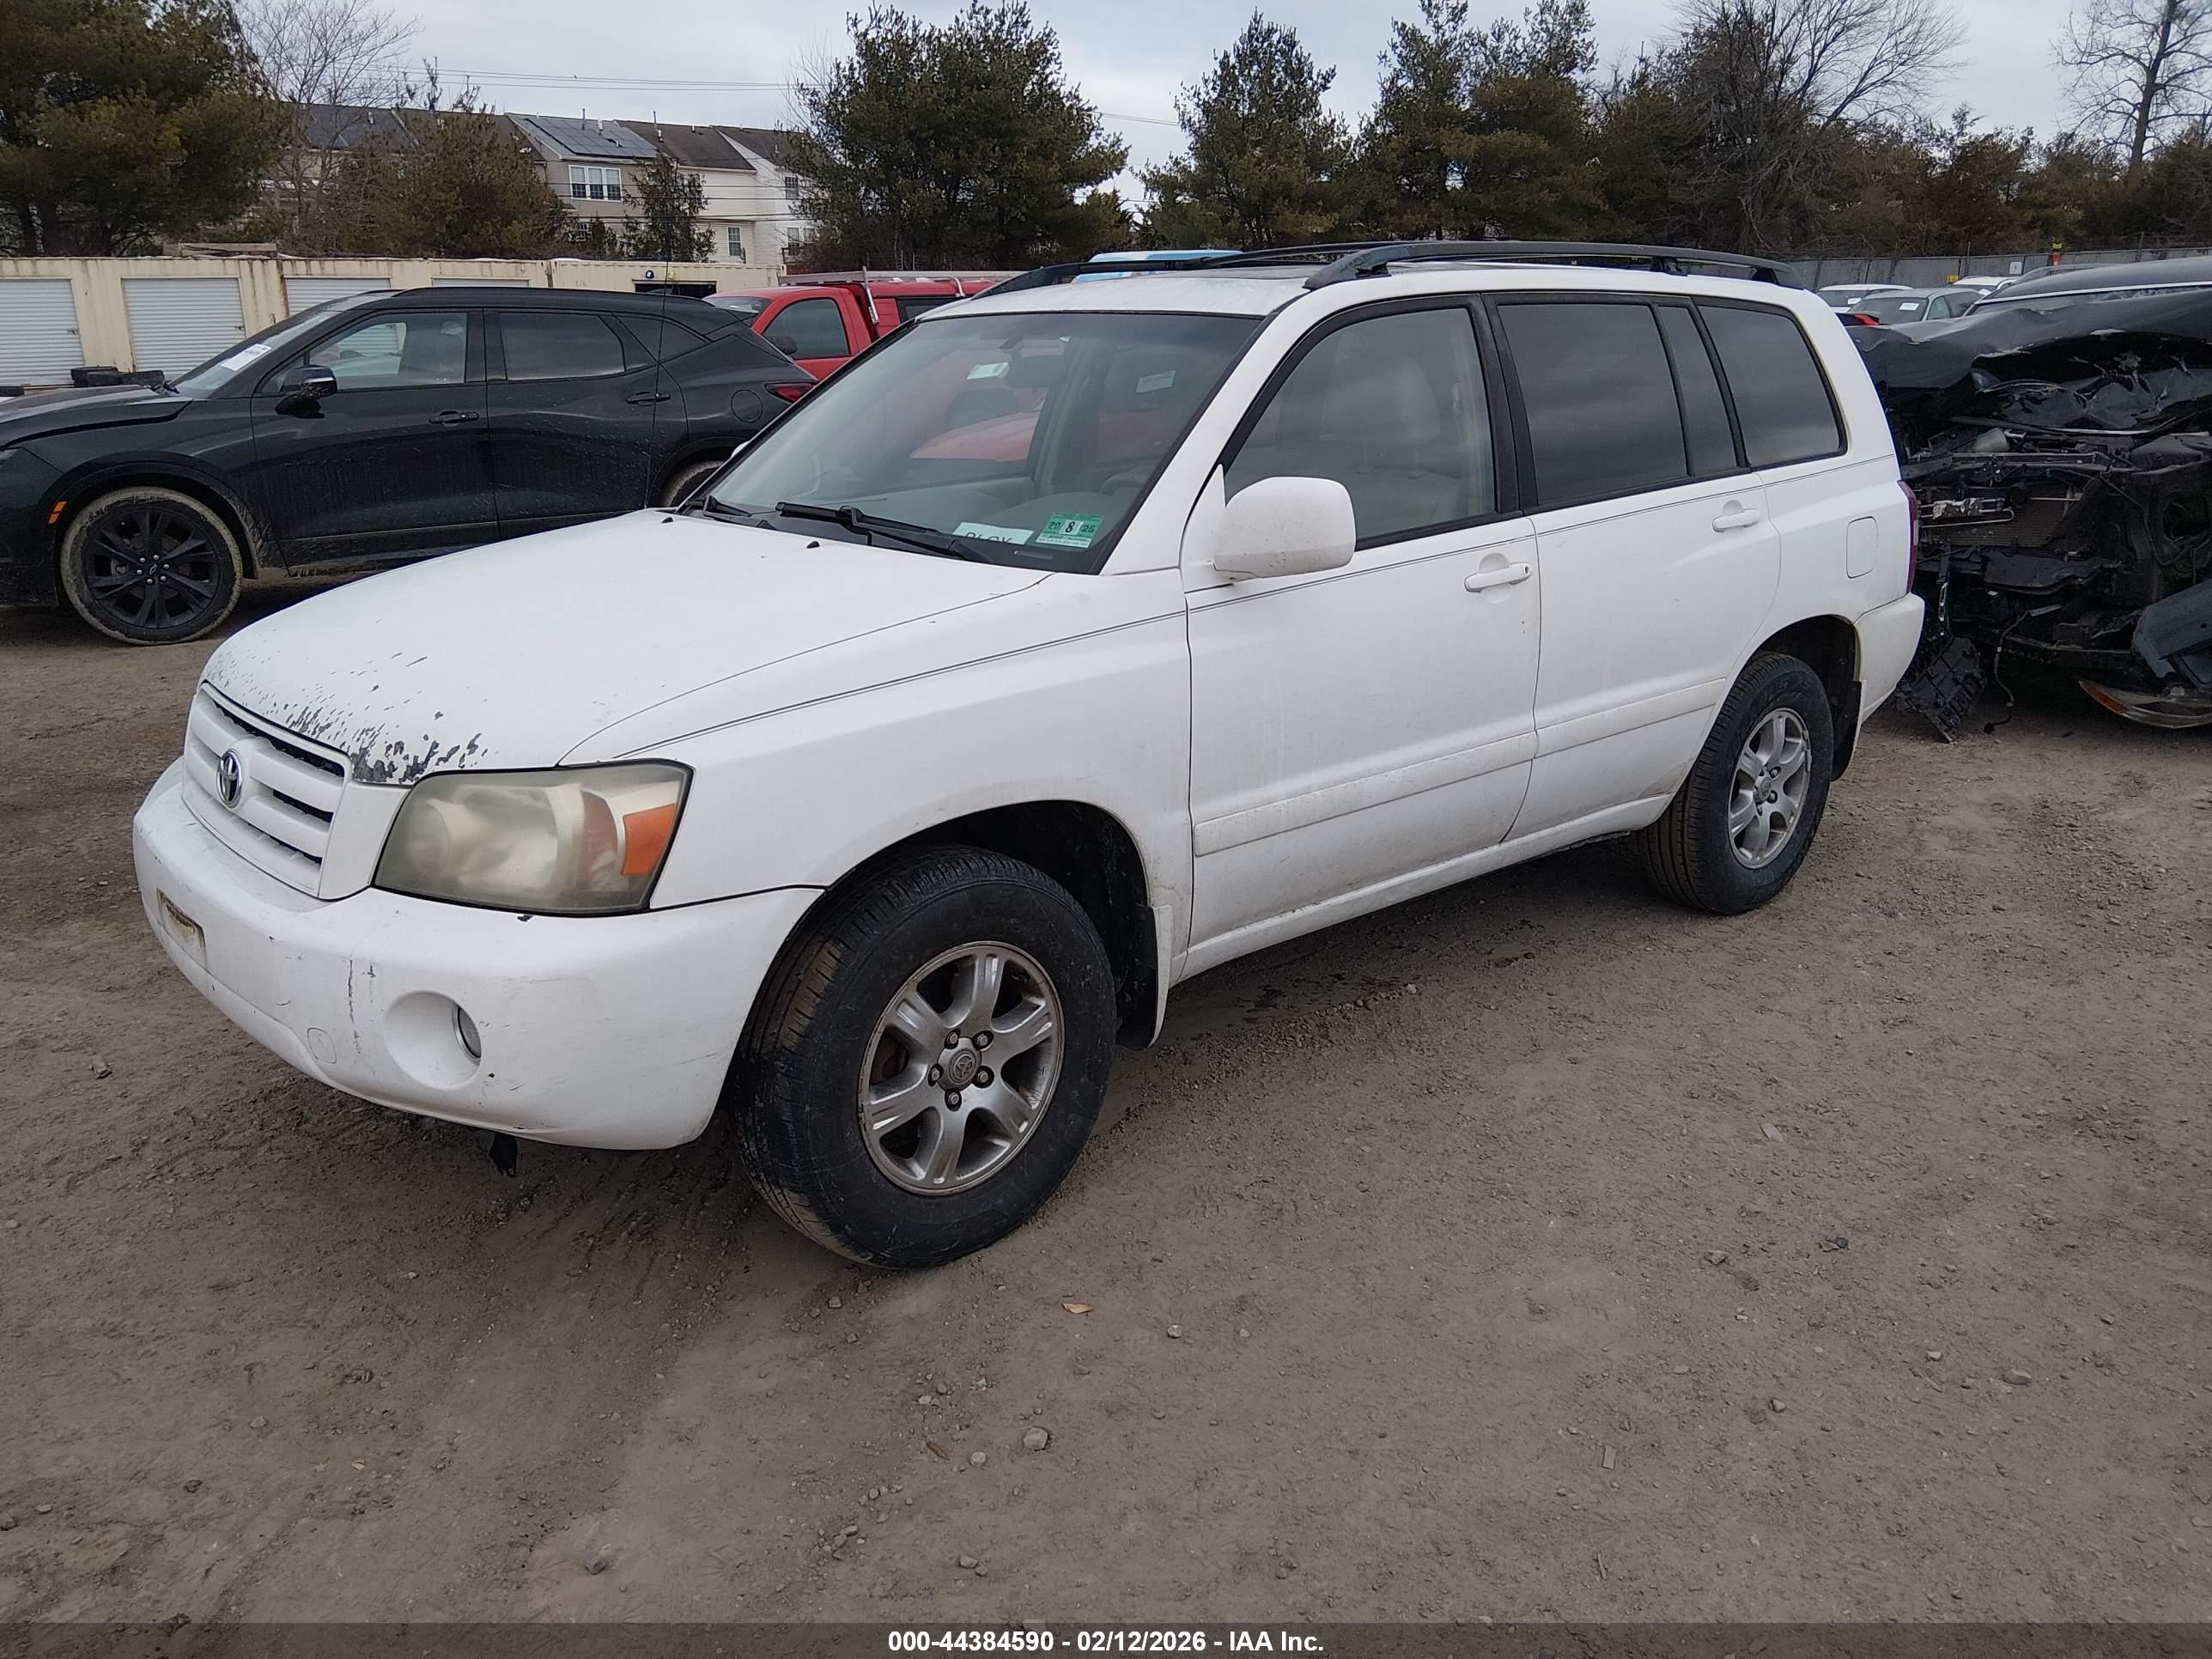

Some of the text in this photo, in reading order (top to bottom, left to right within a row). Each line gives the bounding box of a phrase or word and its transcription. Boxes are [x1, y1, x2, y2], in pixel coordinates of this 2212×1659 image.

[1048, 521, 1097, 533] 20 8 25
